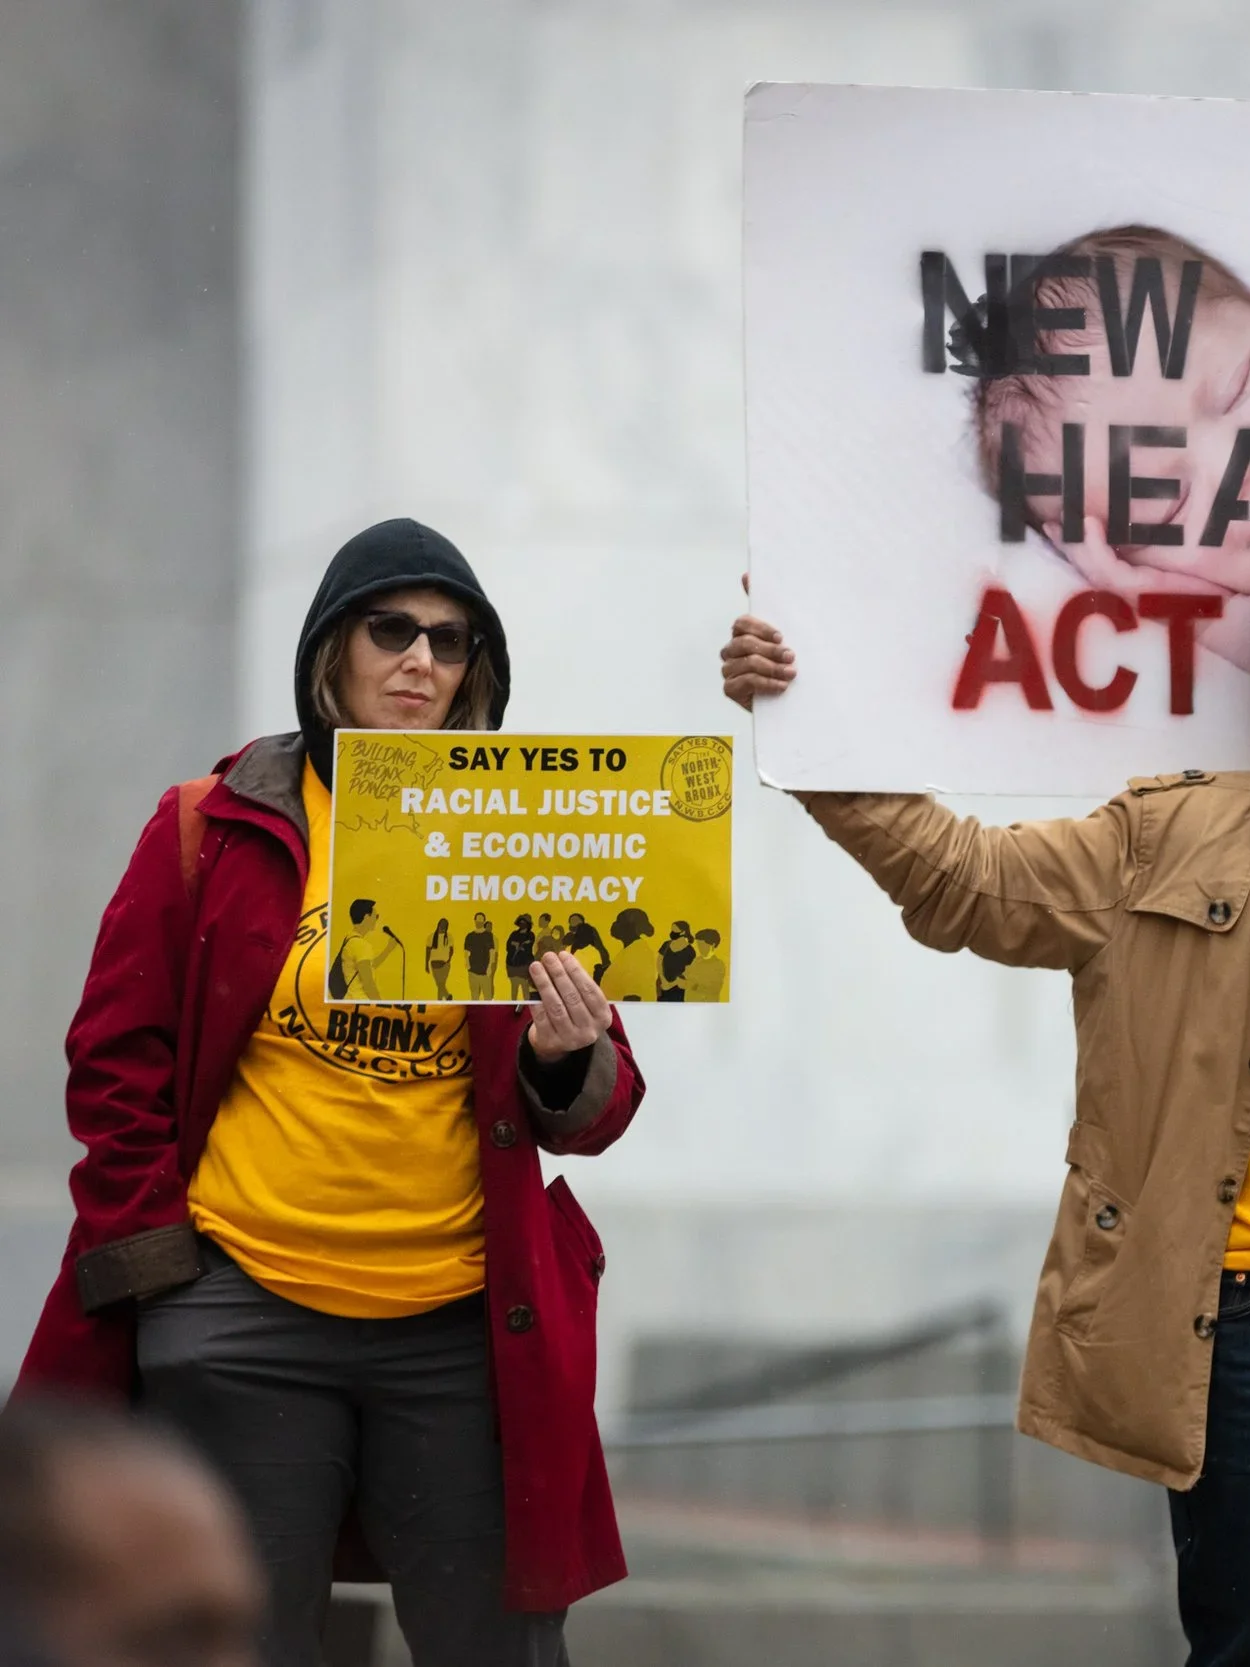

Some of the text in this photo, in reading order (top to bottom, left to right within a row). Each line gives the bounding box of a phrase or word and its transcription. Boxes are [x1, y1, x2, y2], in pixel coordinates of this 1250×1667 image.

[920, 251, 1201, 380] NEW
[951, 588, 1224, 715] ACT
[350, 739, 417, 770] BUILDING
[449, 747, 627, 772] SAY YES TO
[668, 738, 725, 766] SAY YES TO
[352, 759, 405, 784] BRONX
[686, 771, 715, 788] WEST
[348, 777, 401, 802] POWER
[401, 787, 671, 816] RACIAL JUSTICE
[685, 784, 721, 803] BRONX
[424, 831, 646, 859] & ECONOMIC
[426, 875, 644, 902] DEMOCRACY
[326, 1009, 438, 1052] BRONX
